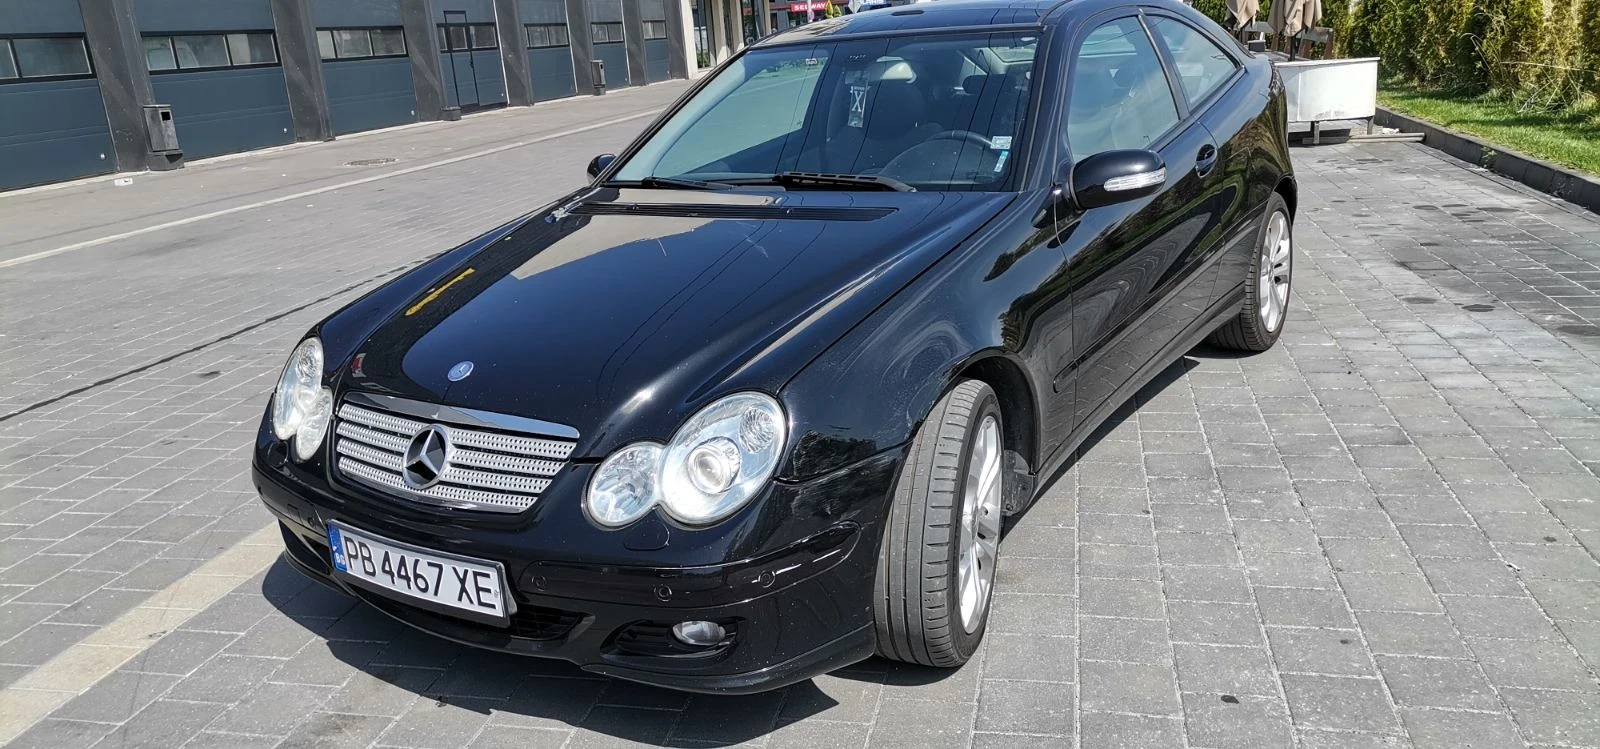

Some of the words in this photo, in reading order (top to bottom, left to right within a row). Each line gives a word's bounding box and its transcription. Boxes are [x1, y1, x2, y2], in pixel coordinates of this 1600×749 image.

[852, 91, 864, 112] X
[344, 536, 376, 577] PB
[381, 550, 443, 597] 4467
[452, 566, 497, 610] XE
